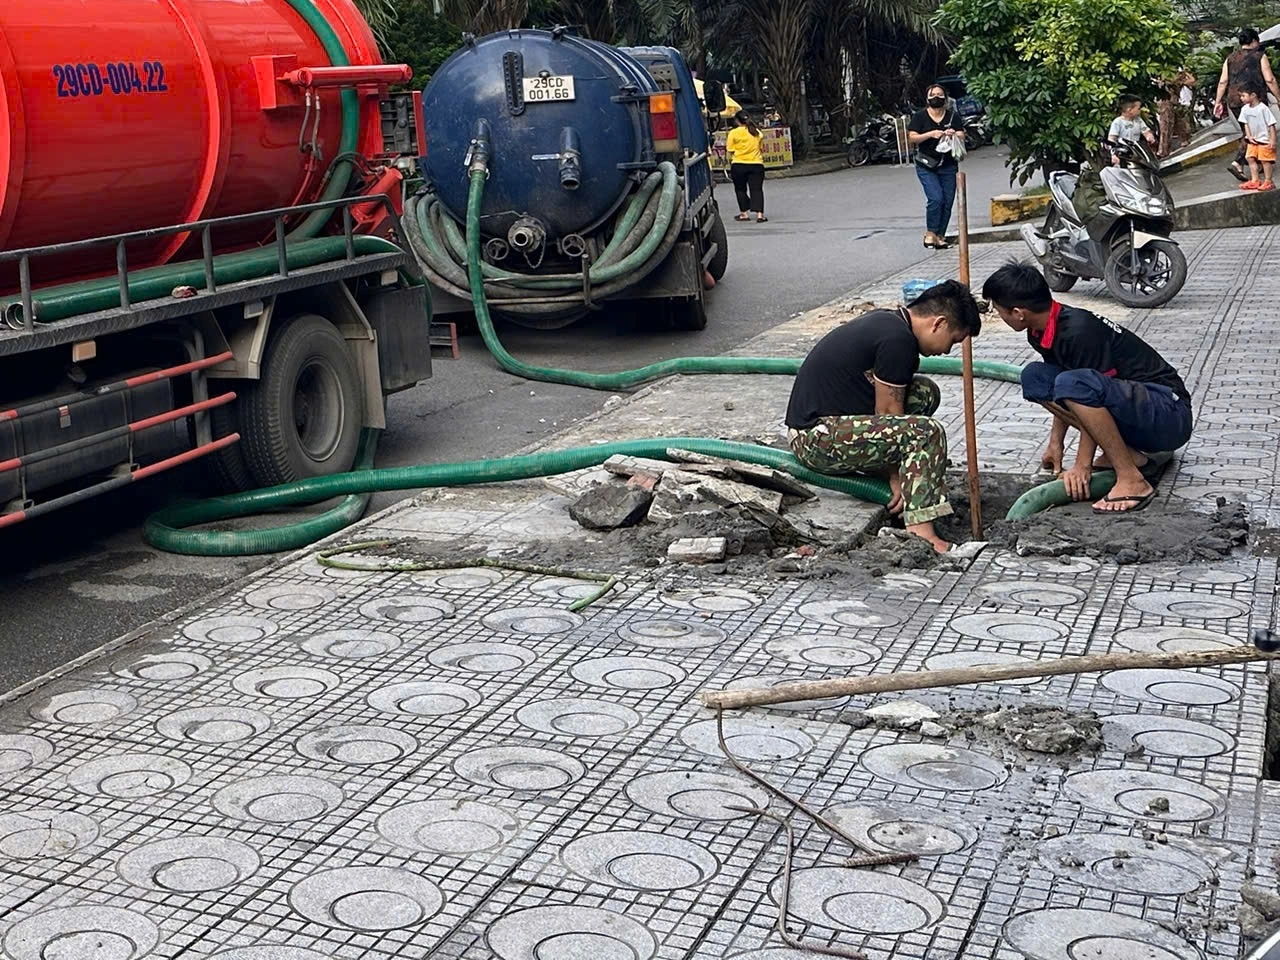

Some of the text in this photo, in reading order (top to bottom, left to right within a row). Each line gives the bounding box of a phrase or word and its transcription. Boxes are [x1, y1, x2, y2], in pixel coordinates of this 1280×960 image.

[53, 61, 168, 97] 29CD-004.22
[534, 78, 563, 88] 29CD
[529, 88, 569, 100] 001.66
